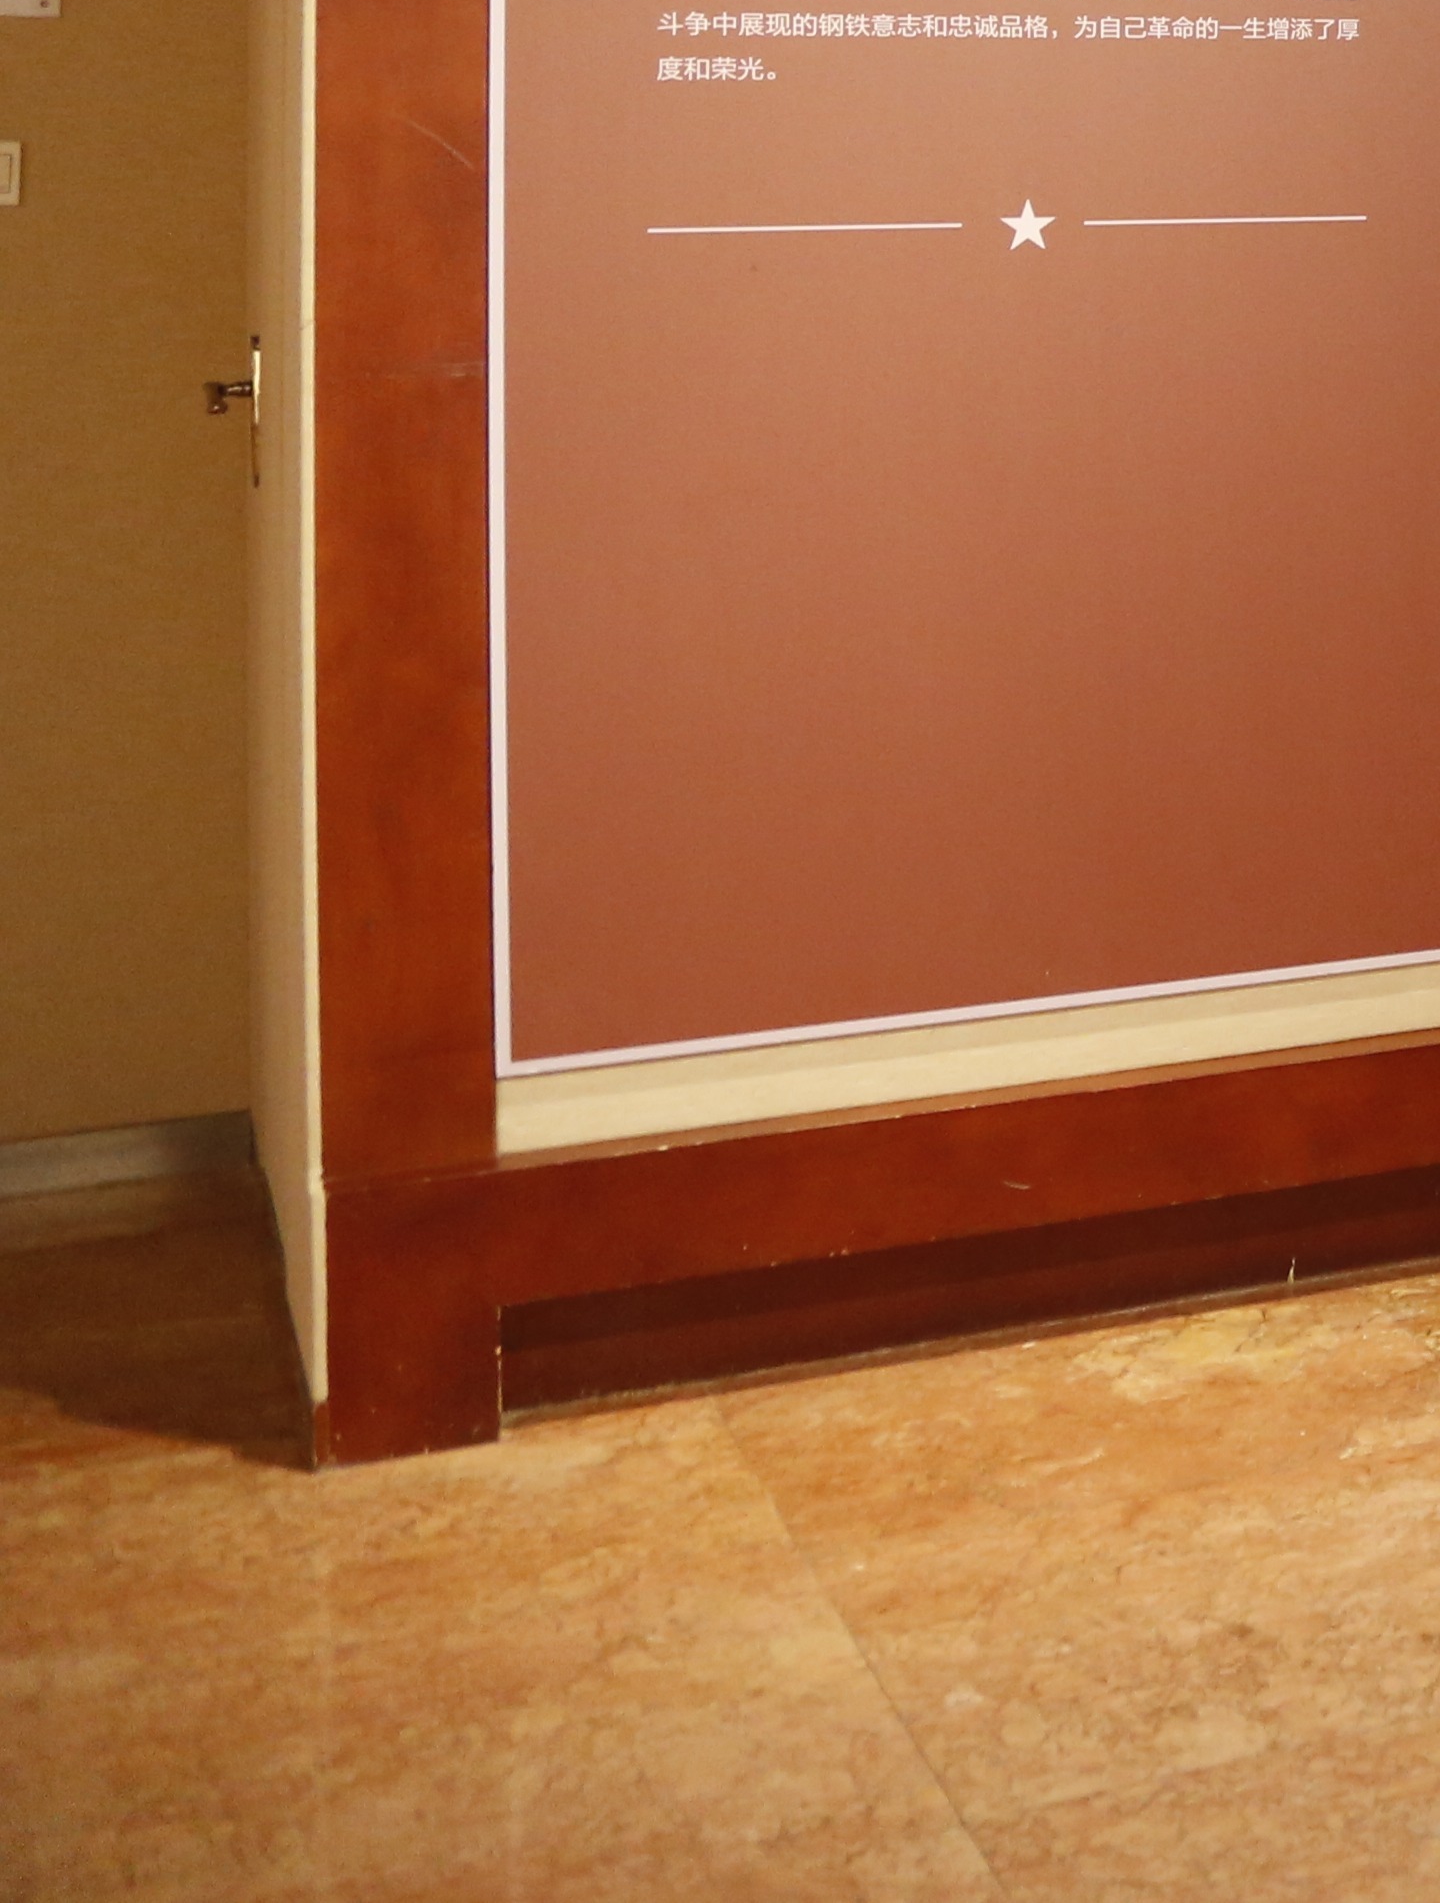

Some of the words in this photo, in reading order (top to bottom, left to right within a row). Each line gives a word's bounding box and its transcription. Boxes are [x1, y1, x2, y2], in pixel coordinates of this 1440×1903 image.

[658, 10, 1360, 42] 斗争中展现的钢铁意志和忠诚品格，为自己革命的一生增添了厚
[658, 57, 778, 82] 度和荣光。
